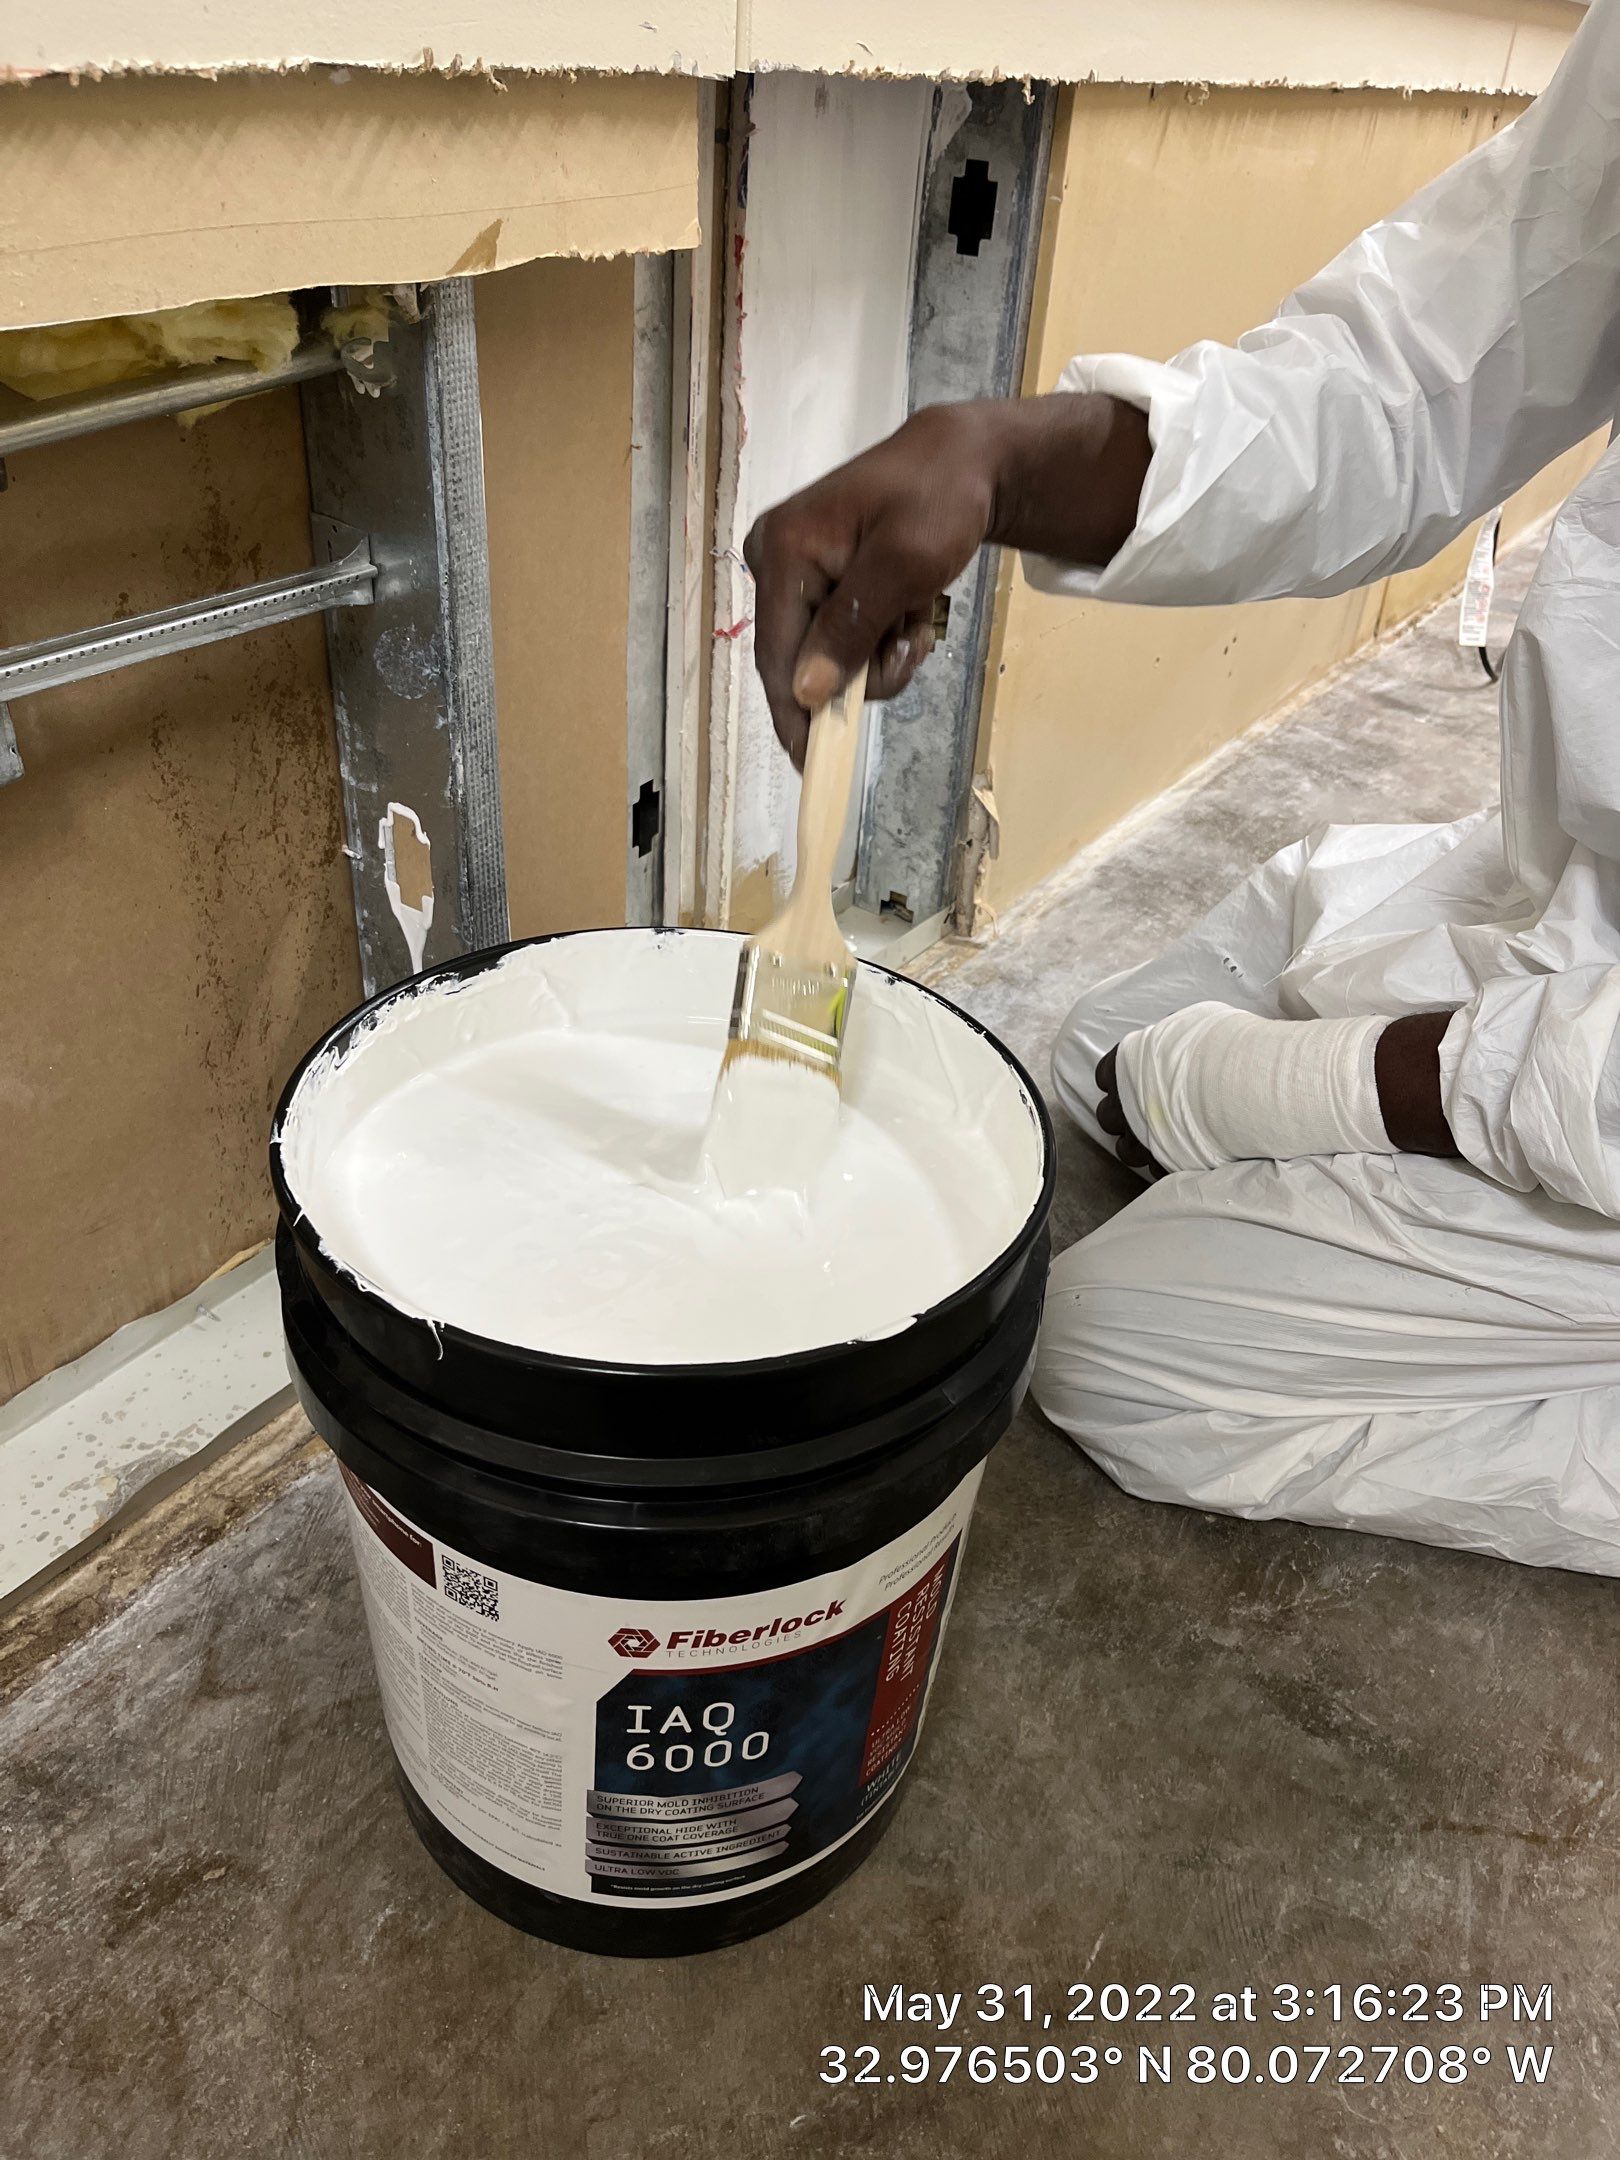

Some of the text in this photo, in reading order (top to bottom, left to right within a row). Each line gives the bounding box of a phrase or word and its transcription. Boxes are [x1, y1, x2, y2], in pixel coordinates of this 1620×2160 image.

[666, 1598, 847, 1650] Fiberlock
[900, 1582, 930, 1681] RESISTANT
[667, 1630, 802, 1658] TECHNOLOGIES
[886, 1601, 912, 1681] COATING
[626, 1702, 735, 1736] IAQ
[626, 1731, 770, 1773] 6000
[596, 1786, 759, 1808] SUPERIOR MOLD INHIBITION
[596, 1792, 765, 1816] ON THE DRY COATING SURFACE
[596, 1818, 737, 1835] EXCEPTIONAL HIDE WITH
[596, 1825, 739, 1842] TRUE ONE COAT COVERAGE
[595, 1829, 781, 1859] SUSTAINABLE ACTIVE INGREDIENT
[594, 1864, 680, 1876] ULTRA LOW VOC
